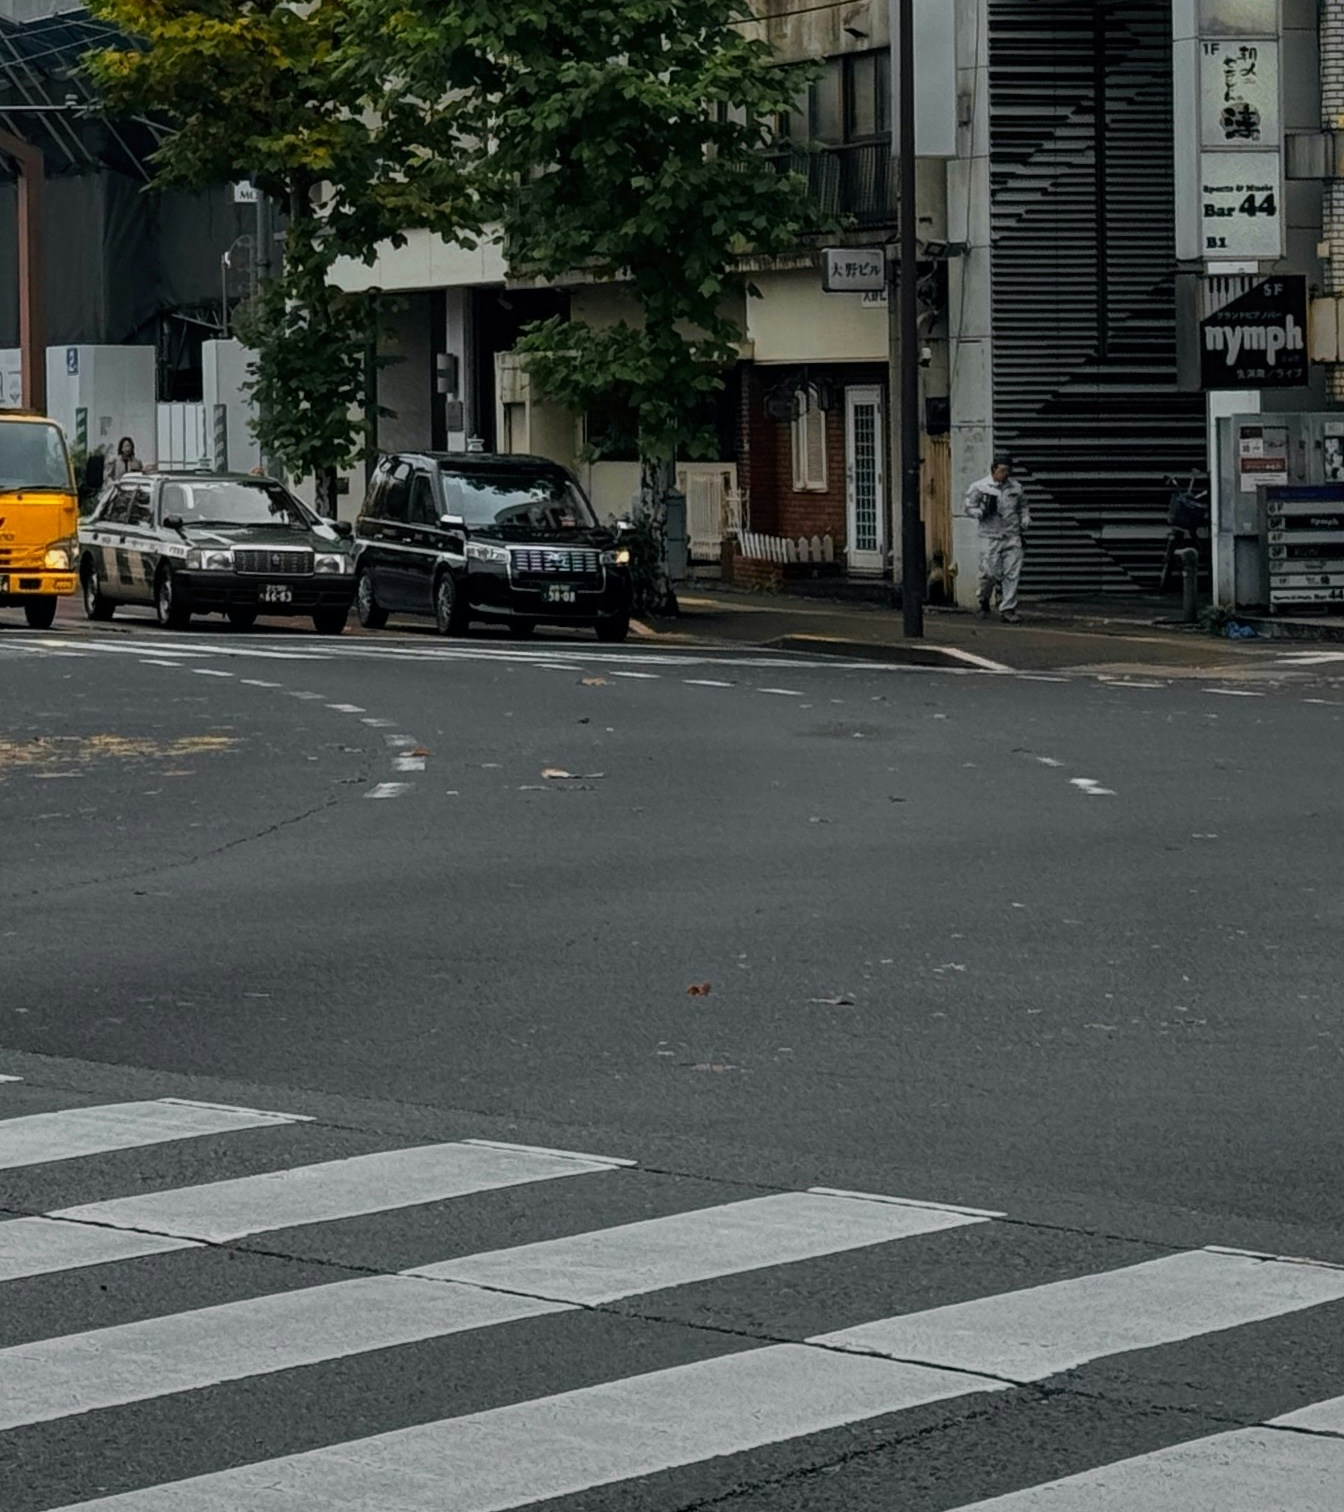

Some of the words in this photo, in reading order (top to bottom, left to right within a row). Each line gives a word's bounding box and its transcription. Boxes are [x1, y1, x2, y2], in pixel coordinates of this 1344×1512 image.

[1203, 43, 1220, 55] 1F
[1204, 204, 1236, 217] Bar
[1239, 193, 1277, 217] 44
[831, 261, 881, 278] 大野ビル
[1204, 313, 1305, 366] nymph
